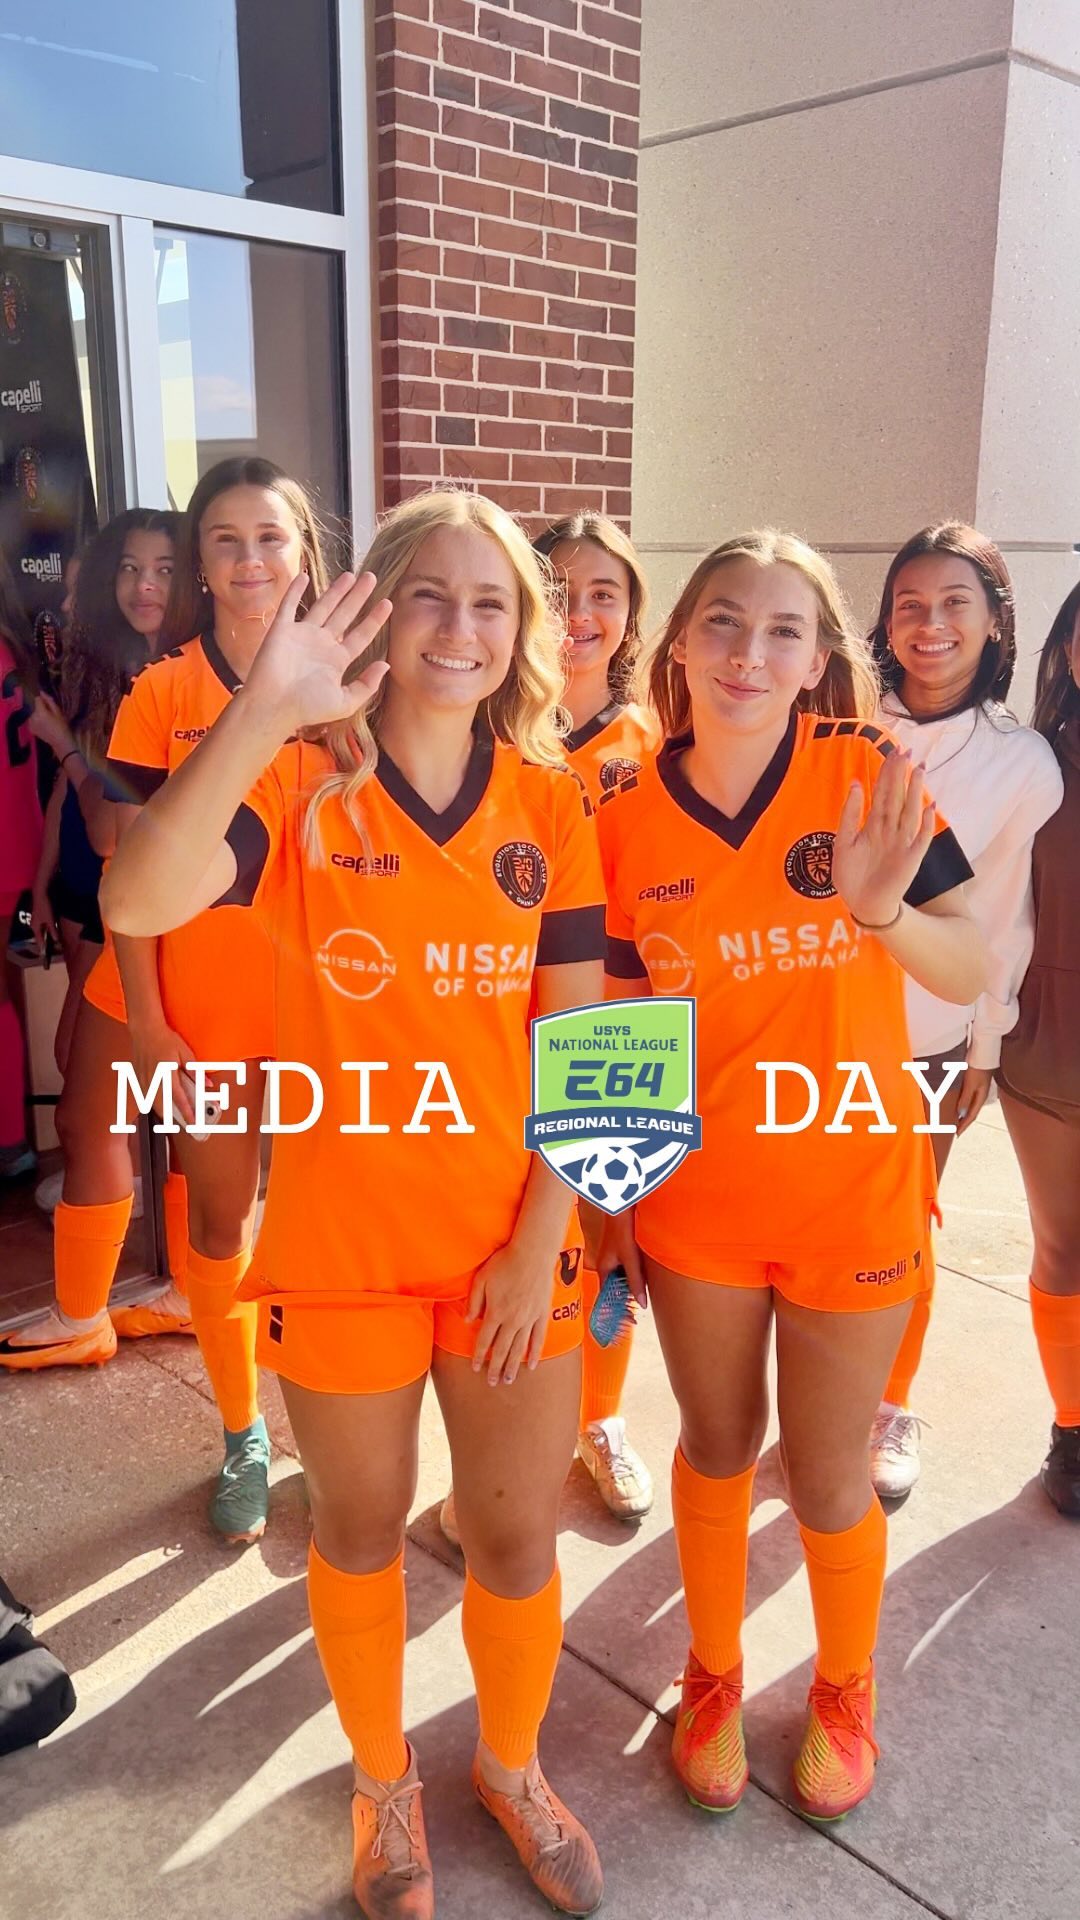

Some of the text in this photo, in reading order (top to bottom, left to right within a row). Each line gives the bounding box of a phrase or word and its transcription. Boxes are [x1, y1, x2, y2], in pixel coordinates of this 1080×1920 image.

[1, 380, 42, 411] capelli
[21, 553, 62, 579] capelli
[174, 726, 209, 741] cape
[787, 837, 810, 877] EVOLUTION
[638, 878, 695, 901] capelli
[661, 894, 695, 902] SPORT
[719, 918, 862, 962] NISSA
[317, 950, 397, 976] NISSAN
[733, 944, 860, 981] OF OMAHA
[433, 978, 465, 997] OF
[855, 1259, 907, 1286] capelli
